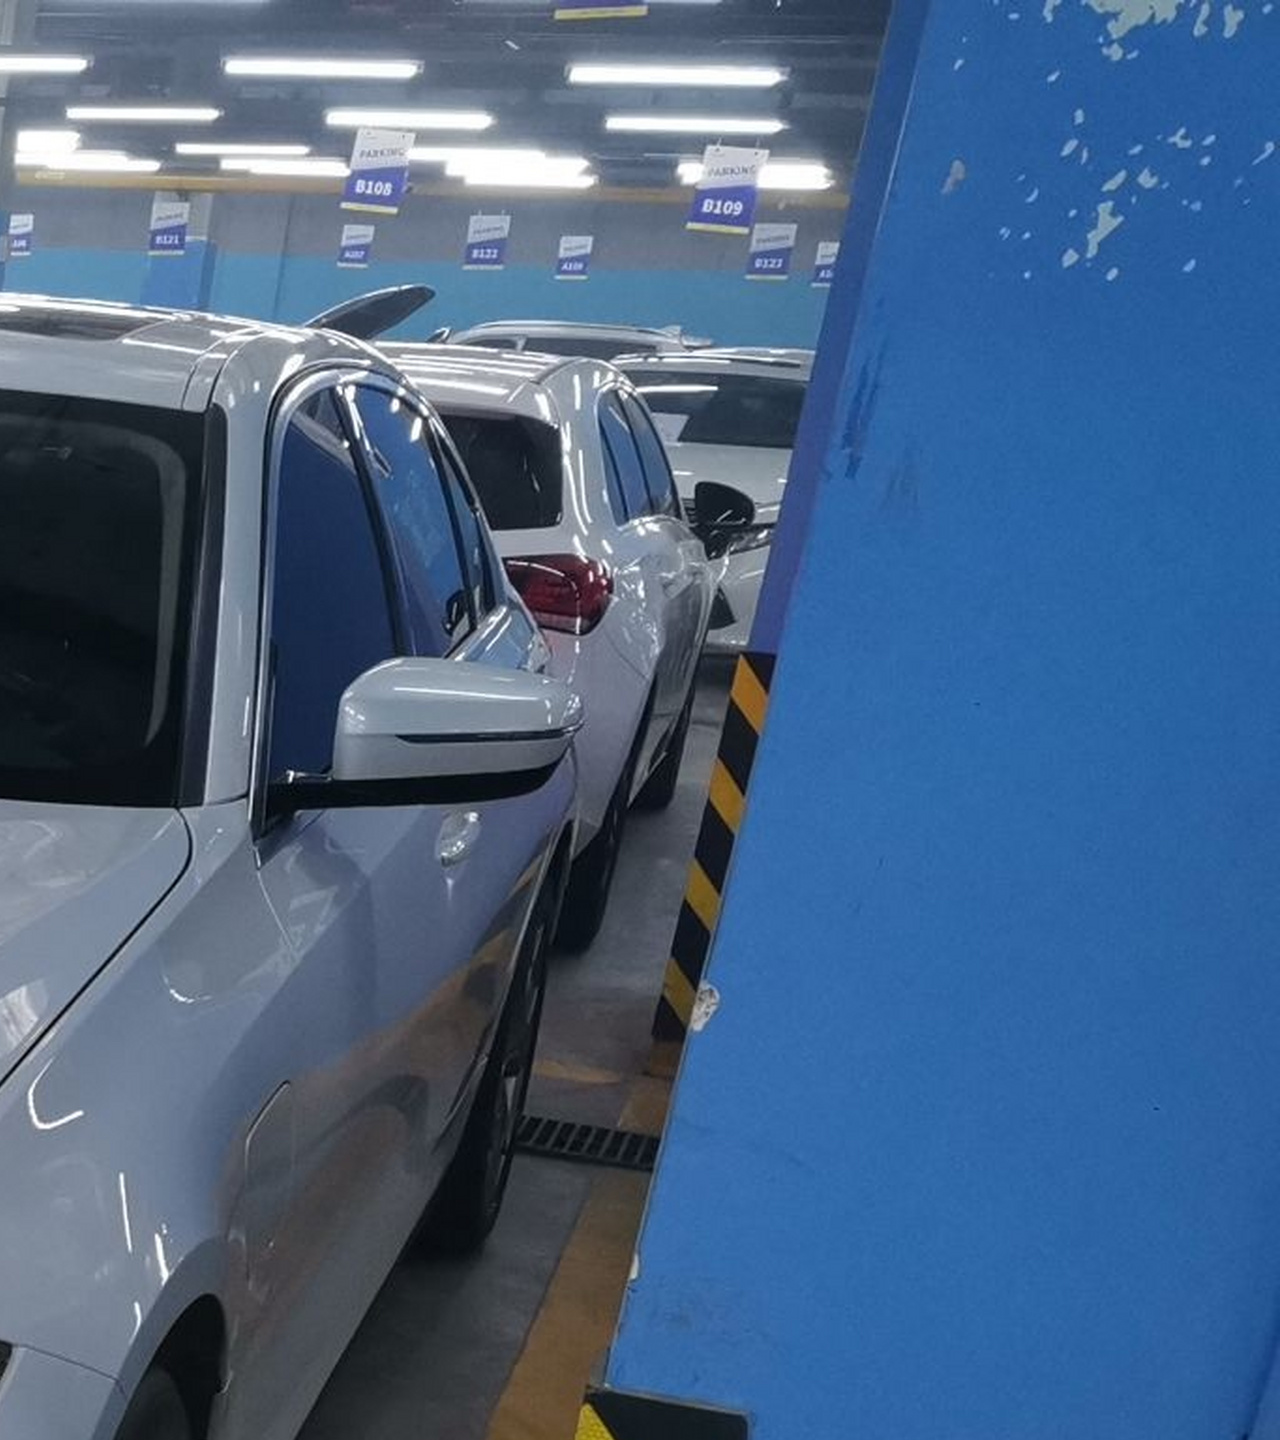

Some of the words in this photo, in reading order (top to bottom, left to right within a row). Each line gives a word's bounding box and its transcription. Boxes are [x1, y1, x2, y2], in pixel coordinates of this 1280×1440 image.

[360, 148, 405, 158] PARKING
[355, 179, 393, 196] B108
[702, 198, 743, 216] B109
